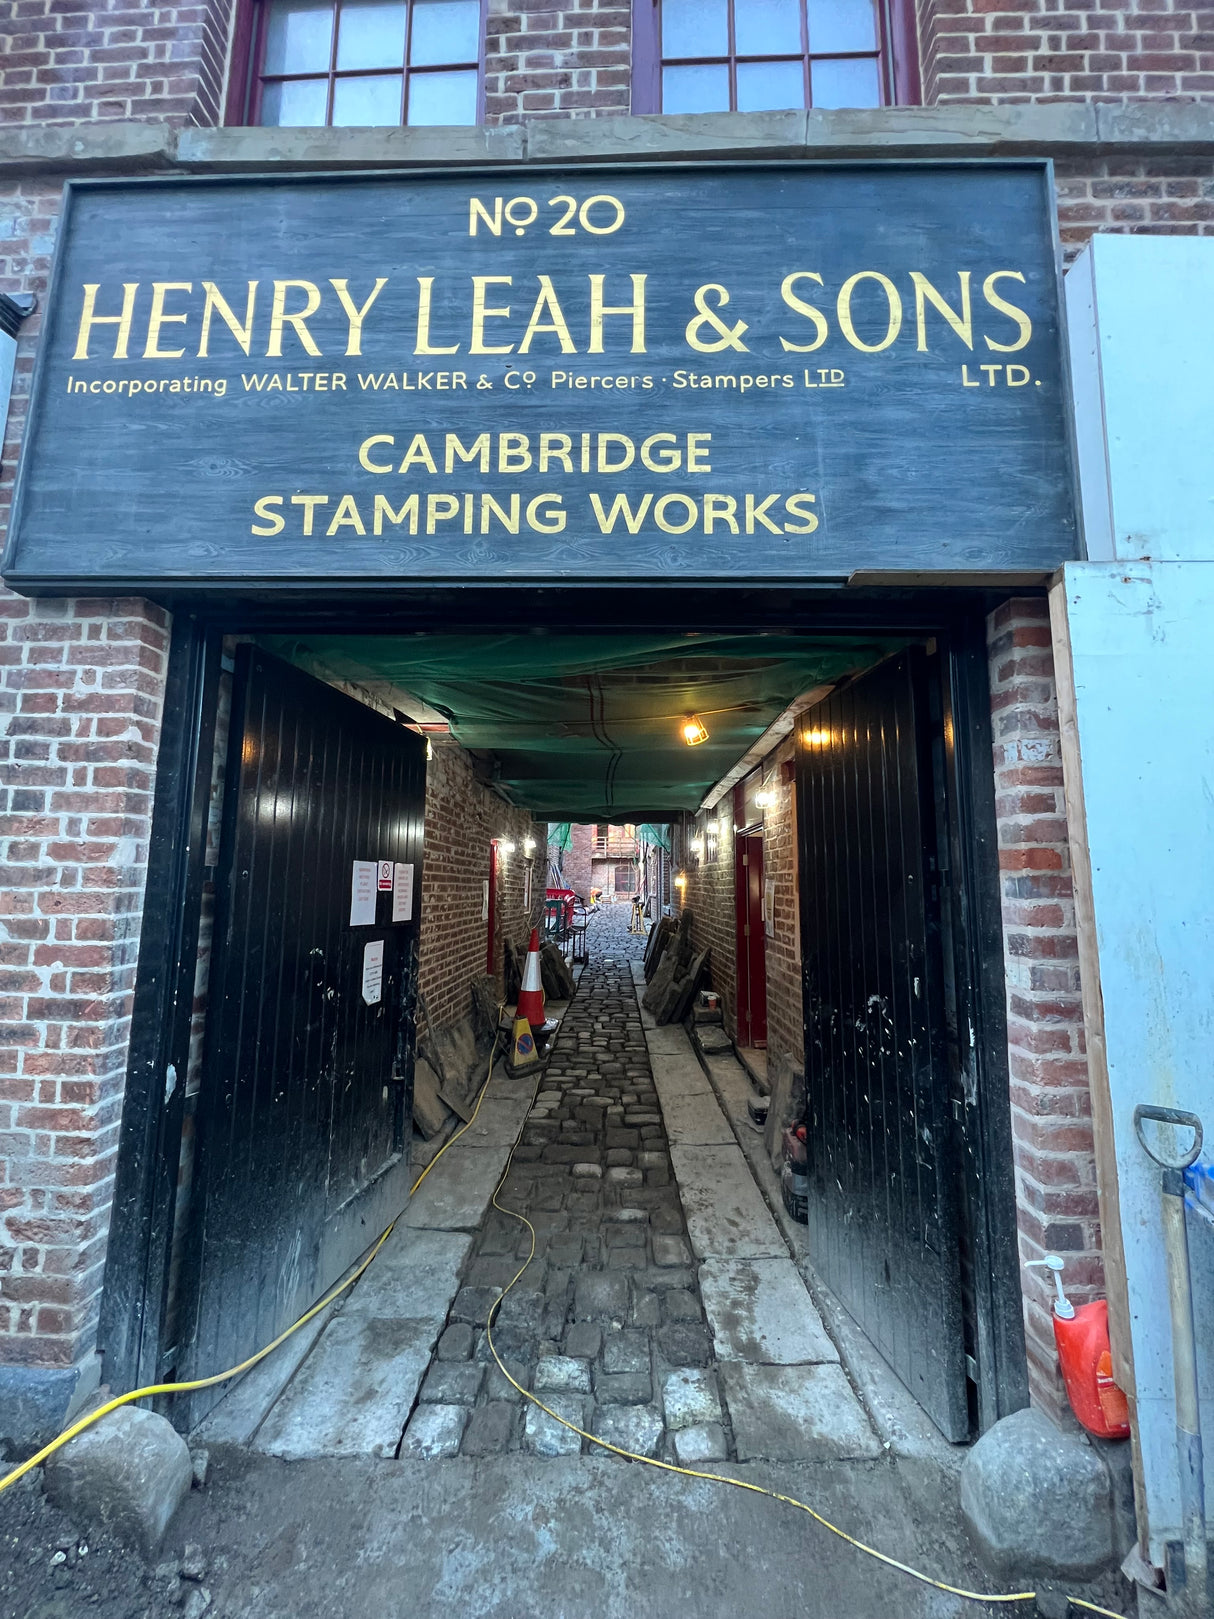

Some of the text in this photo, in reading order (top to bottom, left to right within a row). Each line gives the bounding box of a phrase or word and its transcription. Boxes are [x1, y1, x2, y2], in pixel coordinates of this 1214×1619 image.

[548, 194, 625, 235] 20
[72, 270, 1032, 360] HENRY LEAH & SONS
[66, 375, 228, 397] Incorporating
[241, 372, 347, 391] WALTER
[357, 371, 468, 390] WALKER
[476, 374, 493, 390] &
[551, 371, 654, 389] Piercers
[672, 370, 794, 393] Stampers
[961, 364, 1042, 387] LTD.
[358, 432, 713, 475] CAMBRIDGE
[250, 493, 819, 537] STAMPING WORKS
